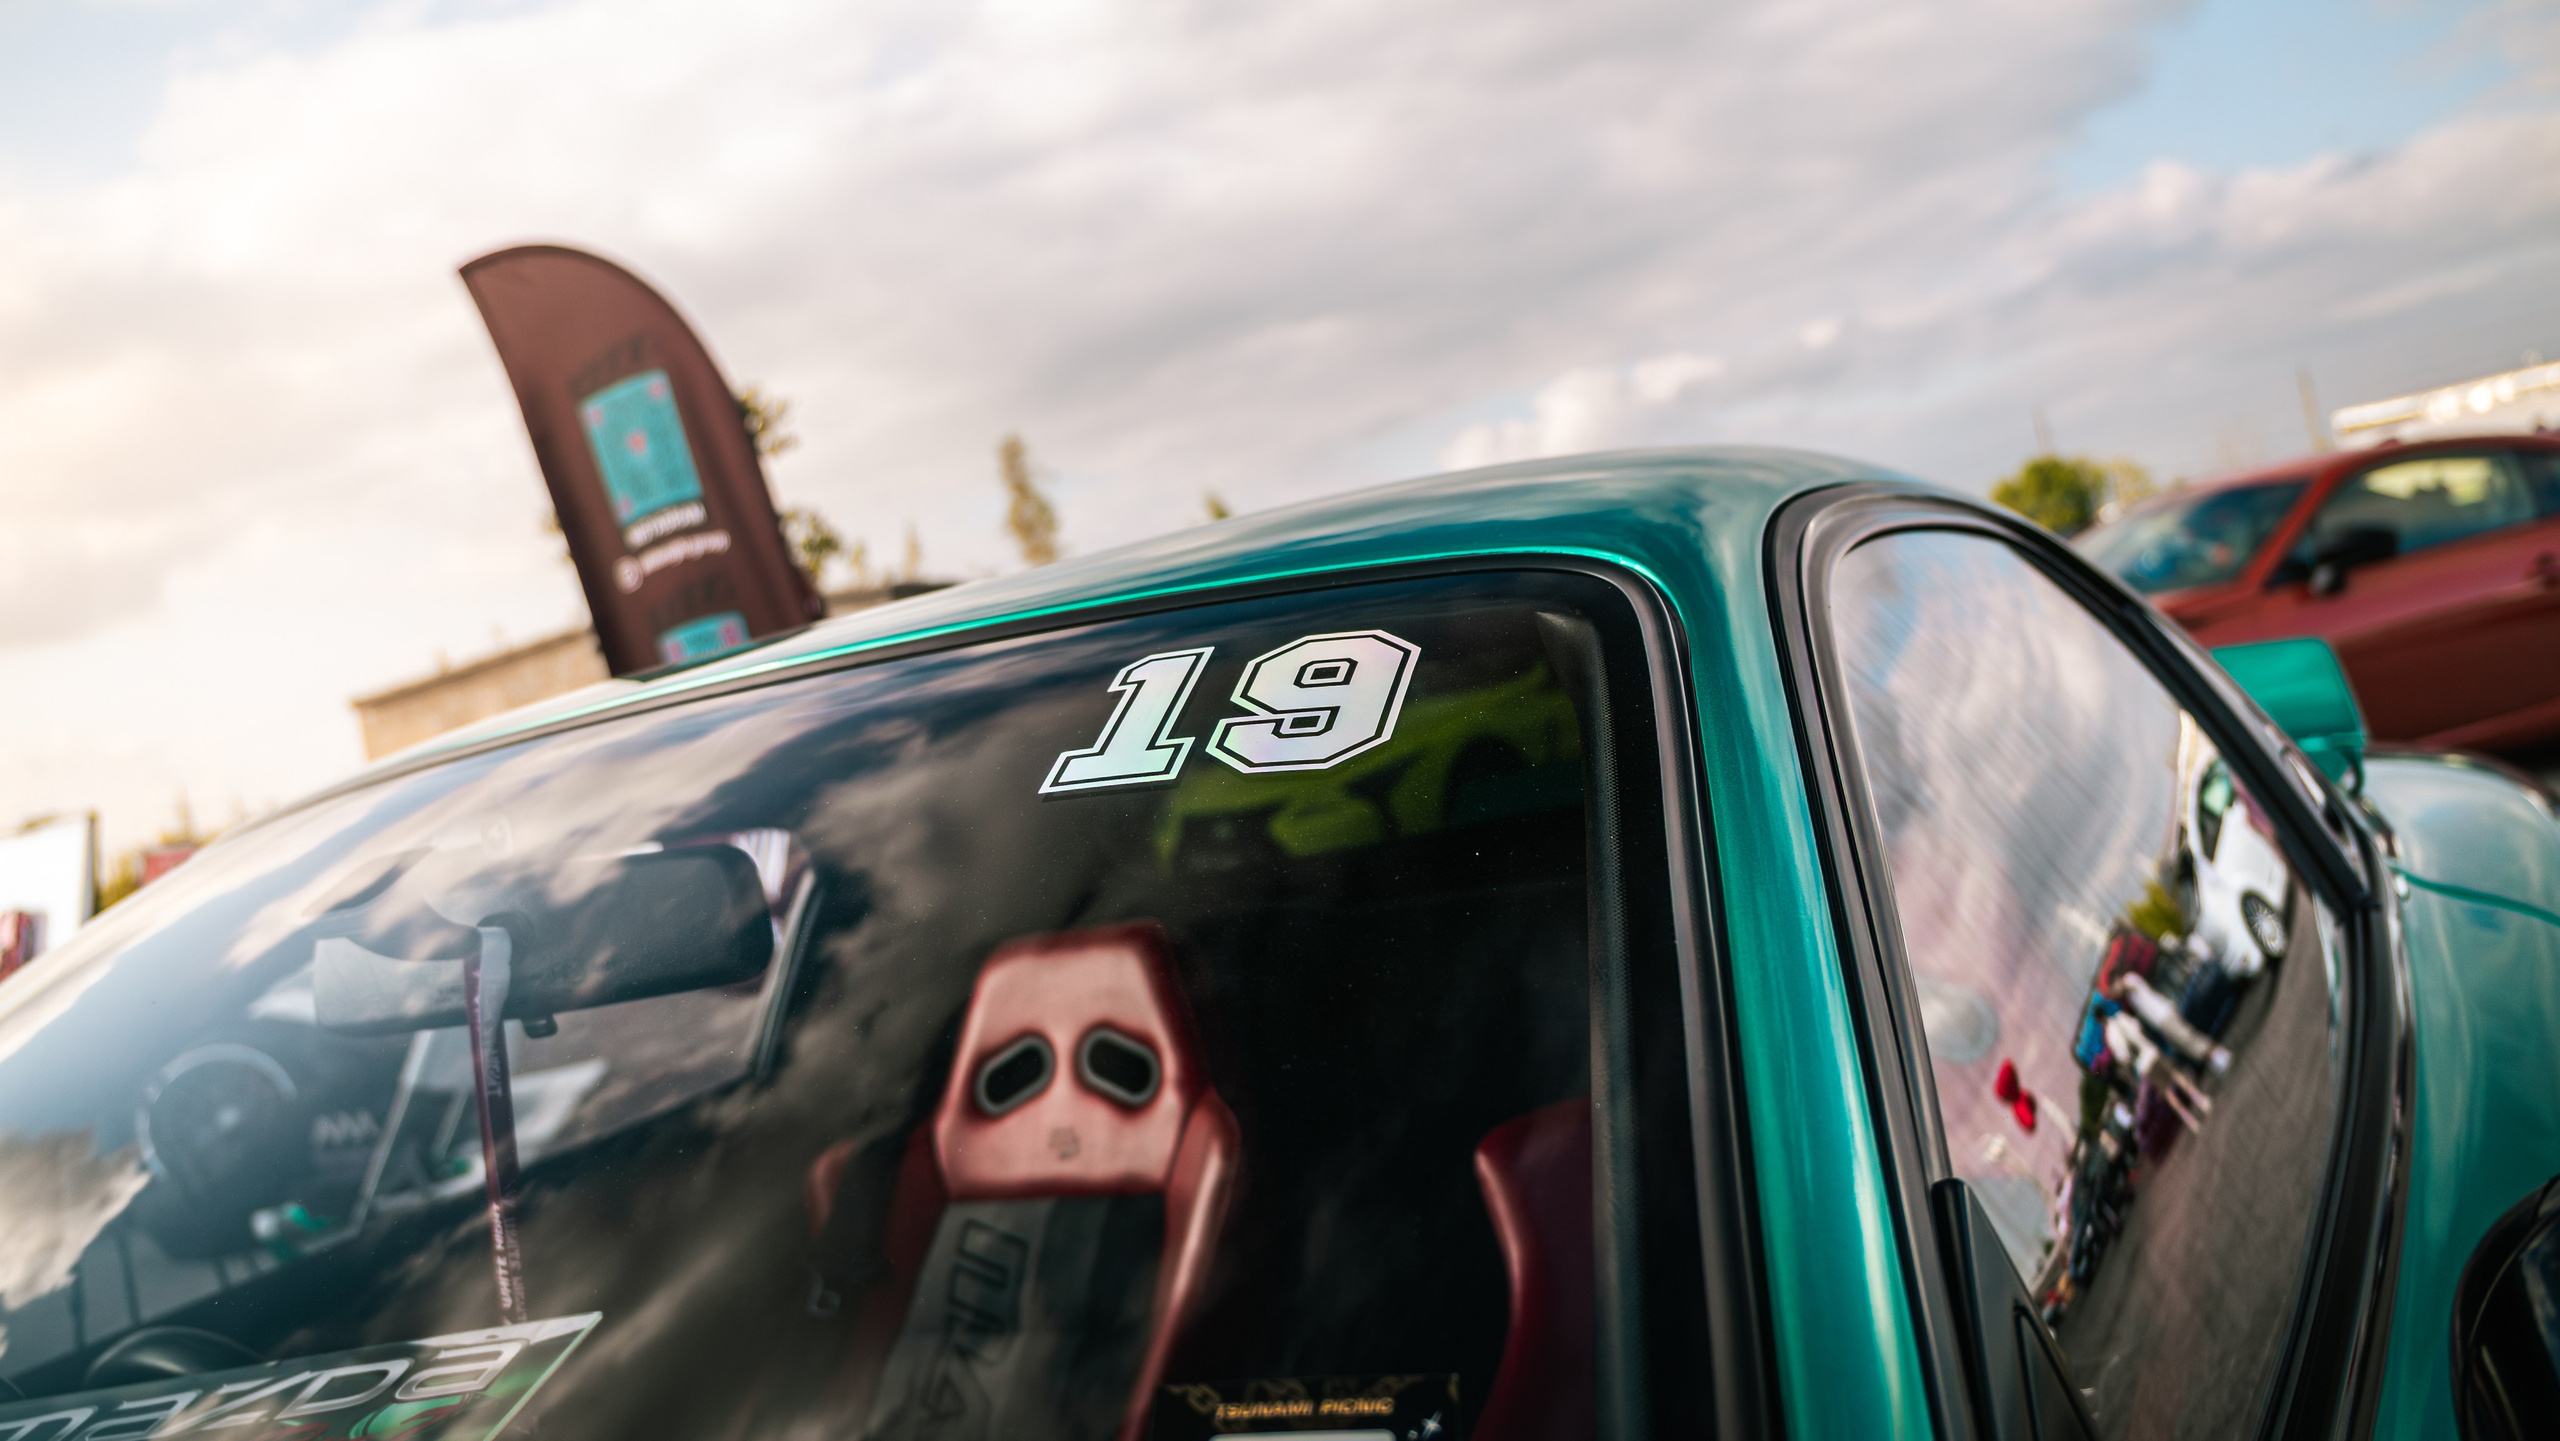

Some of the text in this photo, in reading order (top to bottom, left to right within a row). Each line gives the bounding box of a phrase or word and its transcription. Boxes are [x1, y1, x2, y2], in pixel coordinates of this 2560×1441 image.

[1038, 629, 1422, 794] 19
[1215, 1397, 1395, 1419] TSUNAMI PICNIC
